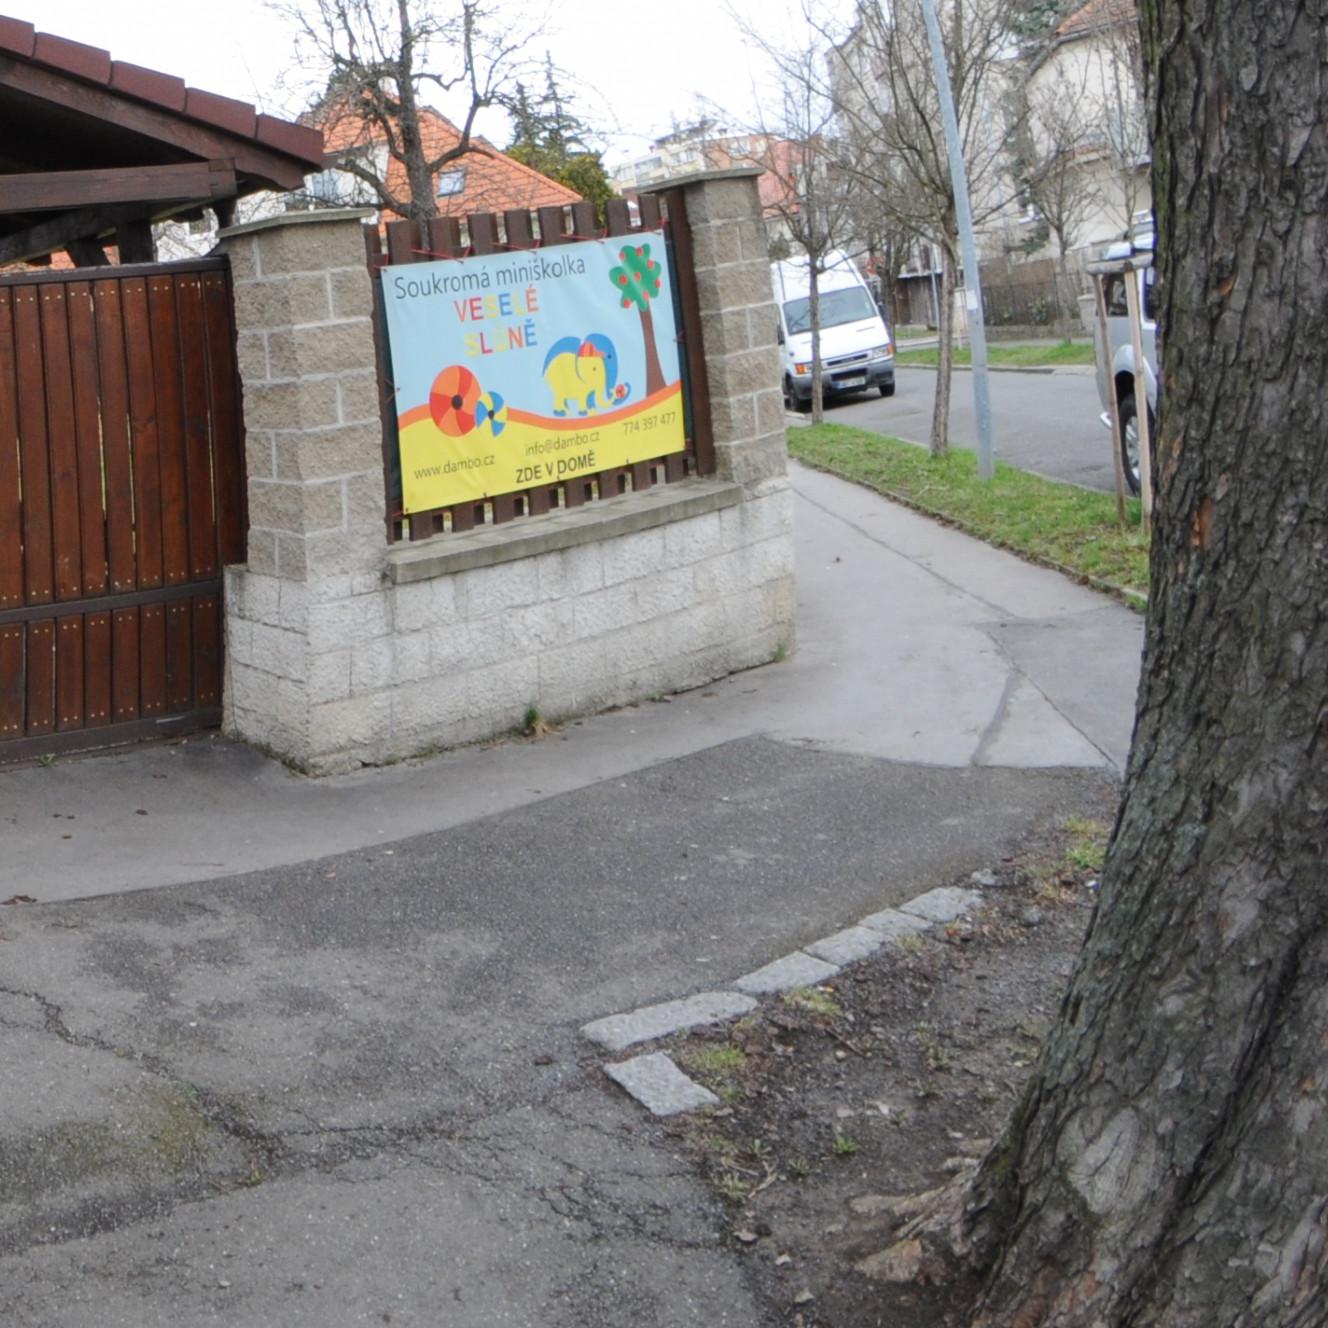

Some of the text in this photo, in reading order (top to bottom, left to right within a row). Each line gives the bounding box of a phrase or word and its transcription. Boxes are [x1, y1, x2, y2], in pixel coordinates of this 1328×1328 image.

[395, 255, 586, 300] Soukromá miniškolka
[454, 283, 539, 322] VESELÉ
[623, 411, 676, 436] 774 397 477
[525, 430, 600, 457] info@dambo.cz
[414, 455, 495, 480] www.dambo.cz
[516, 452, 596, 484] ZDE V DOMĚ
